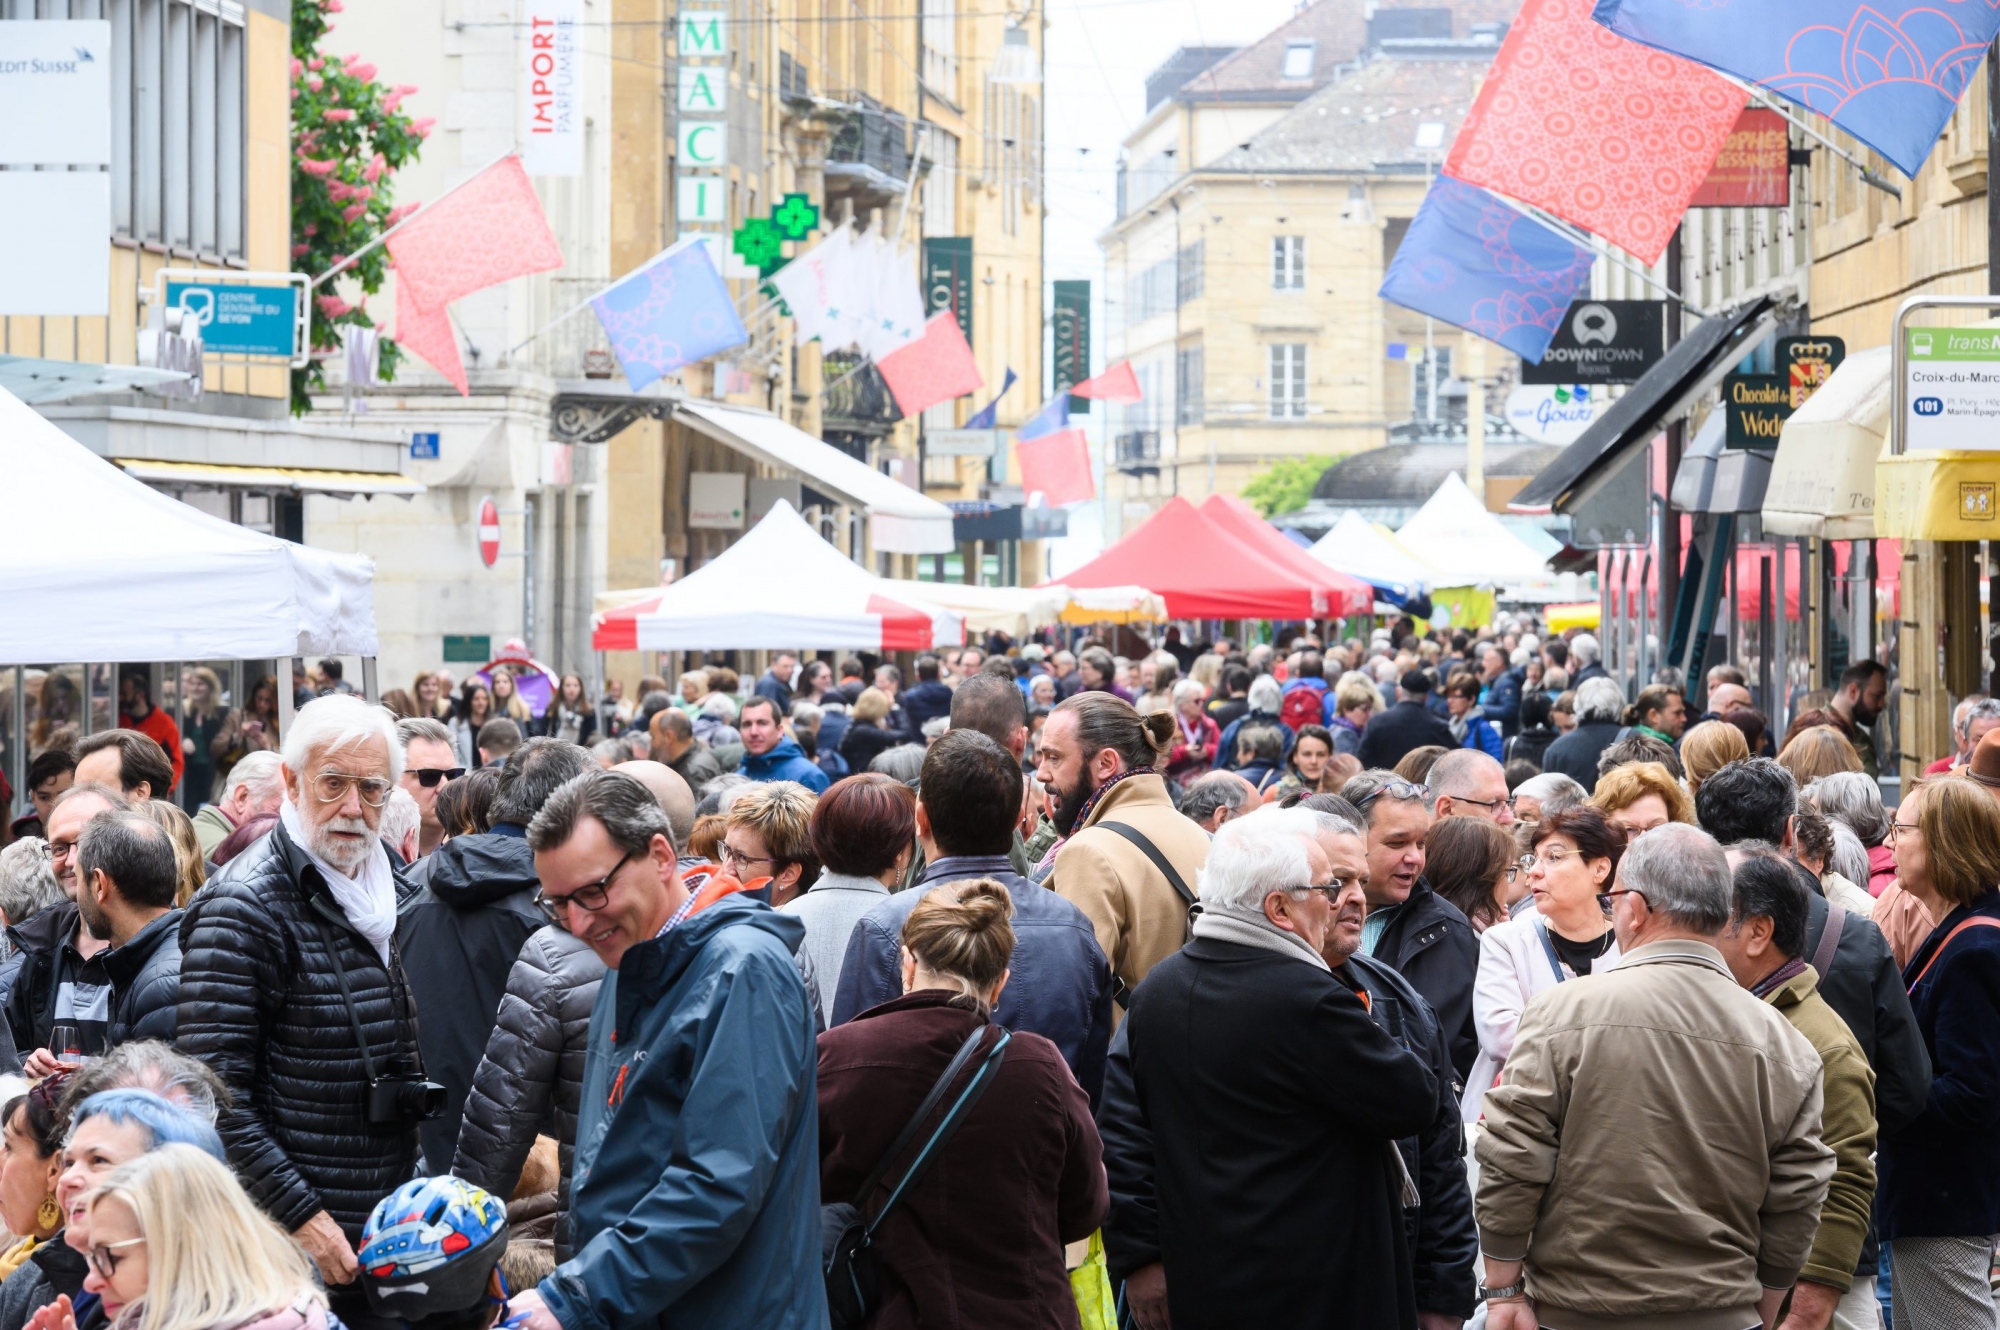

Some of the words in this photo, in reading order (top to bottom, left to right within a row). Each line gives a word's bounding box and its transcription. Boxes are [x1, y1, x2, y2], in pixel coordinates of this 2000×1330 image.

[532, 16, 554, 133] IMPORT
[1544, 348, 1644, 362] DOWNTOWN
[1733, 382, 1779, 404] Chocolat
[1917, 400, 1938, 413] 101
